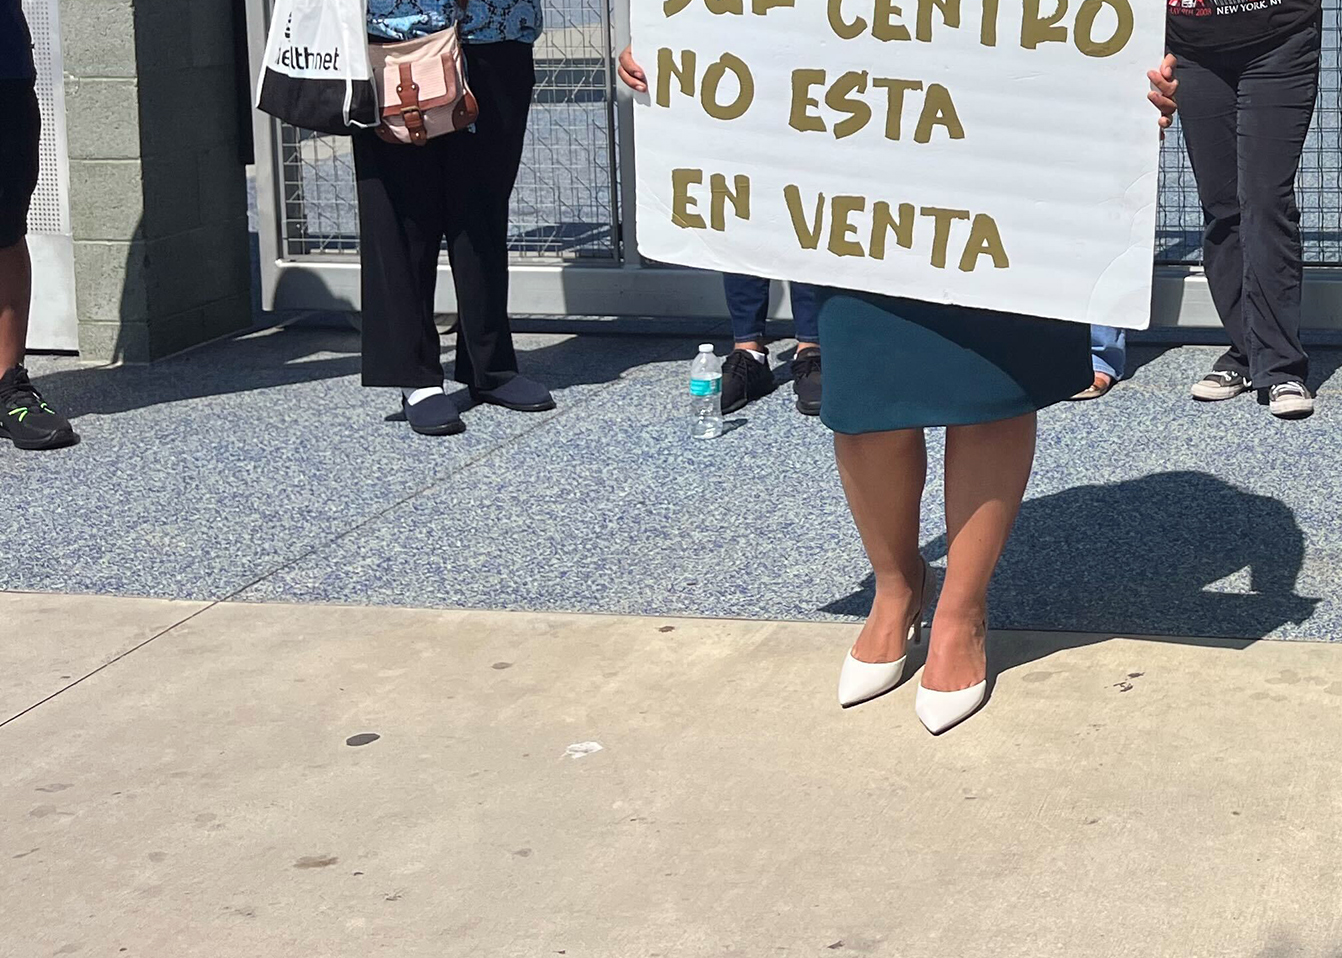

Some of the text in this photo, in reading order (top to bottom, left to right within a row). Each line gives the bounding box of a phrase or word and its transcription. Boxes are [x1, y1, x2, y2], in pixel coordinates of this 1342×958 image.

[1216, 4, 1239, 16] NEW
[655, 47, 966, 144] NO ESTA
[670, 167, 1010, 273] EN VENTA
